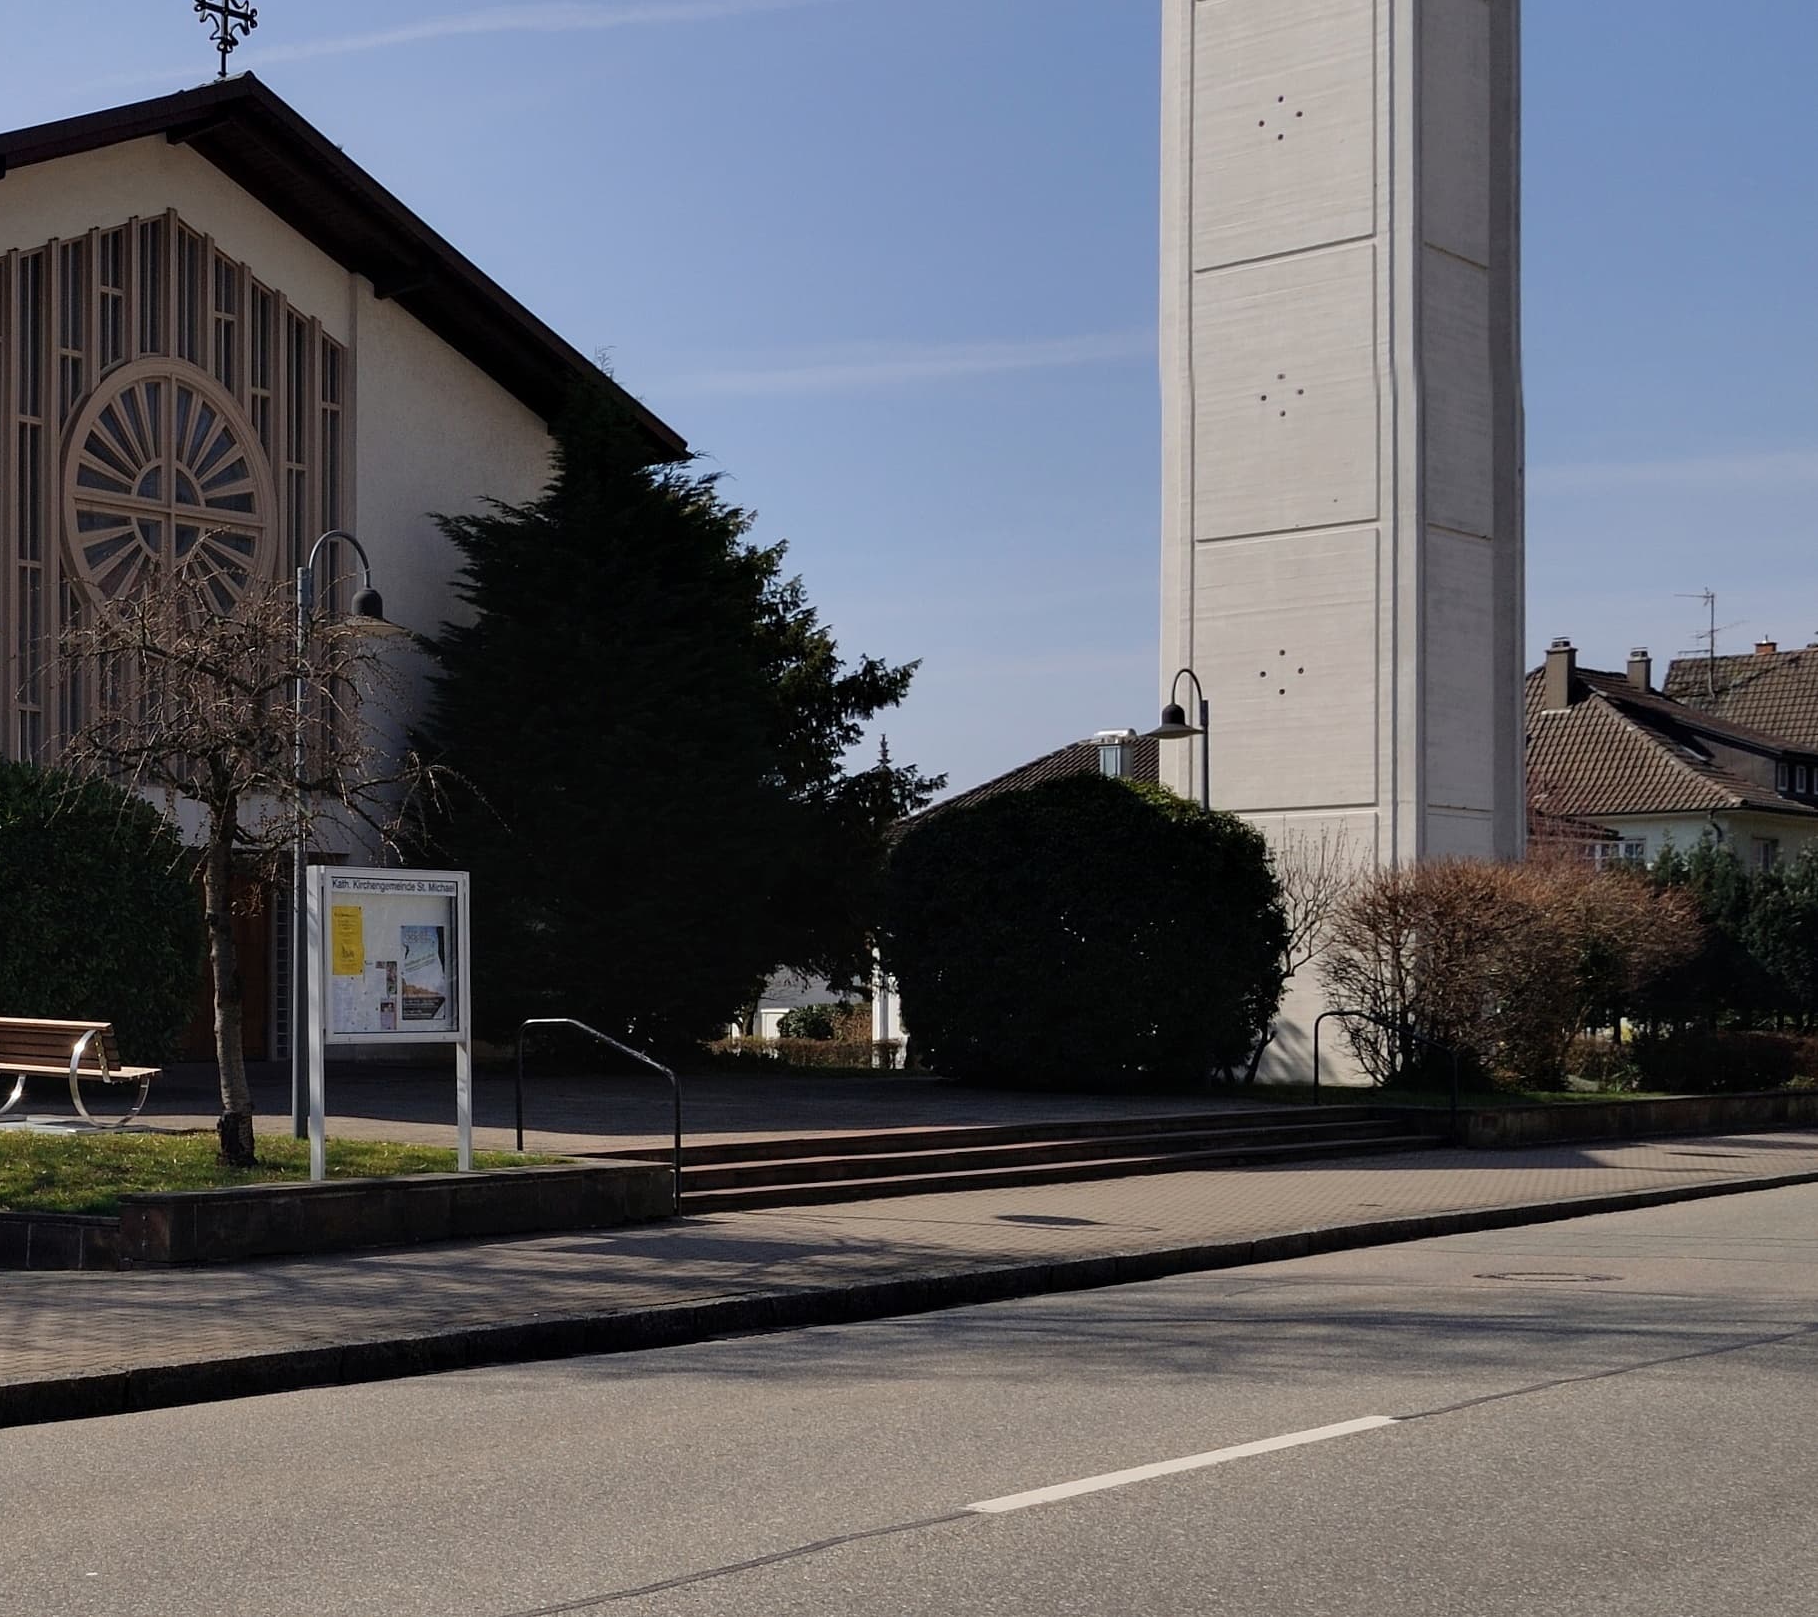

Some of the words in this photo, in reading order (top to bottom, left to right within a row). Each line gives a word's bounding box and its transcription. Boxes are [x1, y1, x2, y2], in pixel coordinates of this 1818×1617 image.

[332, 879, 350, 889] Kath.
[353, 880, 415, 893] Kirchengemeinde
[417, 882, 427, 892] St.
[428, 883, 455, 893] Michael
